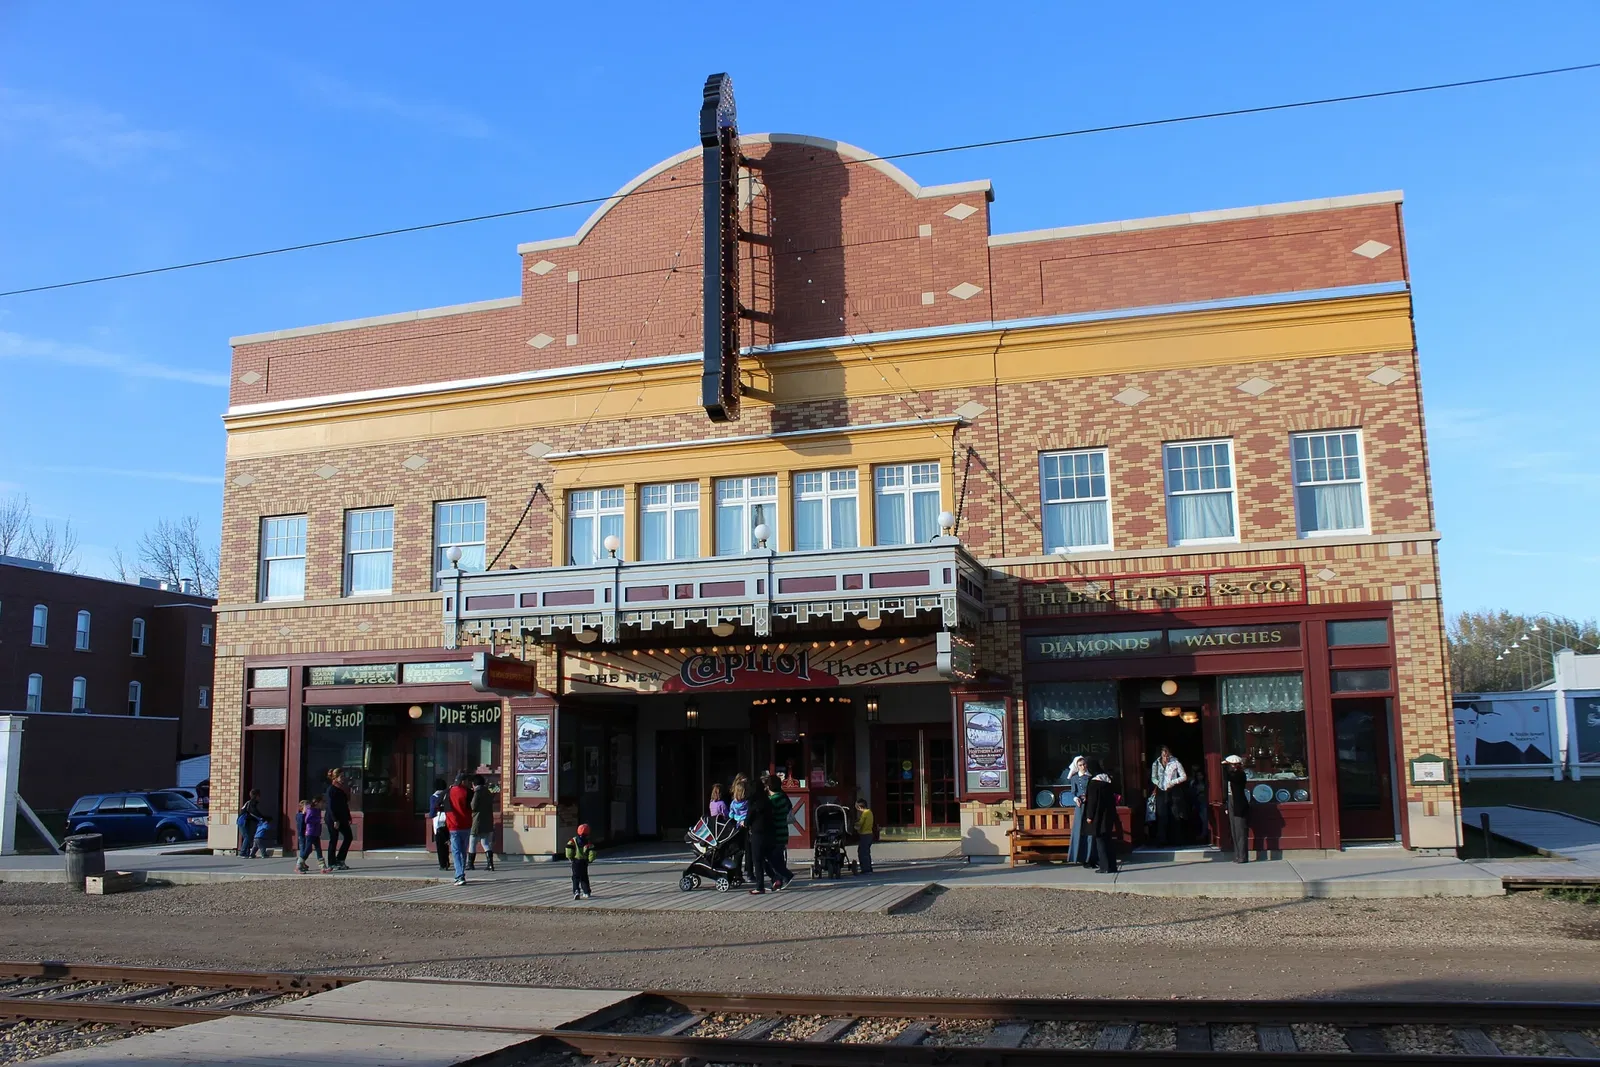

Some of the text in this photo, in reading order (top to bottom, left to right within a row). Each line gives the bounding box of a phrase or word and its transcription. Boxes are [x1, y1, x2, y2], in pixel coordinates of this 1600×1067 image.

[1096, 584, 1206, 603] KLINE
[1216, 582, 1240, 596] &
[1247, 579, 1295, 594] CO.
[1040, 637, 1150, 654] DIAMONDS
[1184, 630, 1282, 647] WATCHES
[341, 671, 394, 680] ALBERT
[679, 650, 920, 688] Capitol Theatre
[585, 672, 662, 684] THE NEW
[335, 711, 363, 727] SHOP
[439, 705, 501, 724] PIPE SHOP
[1060, 743, 1110, 754] KLINE'S
